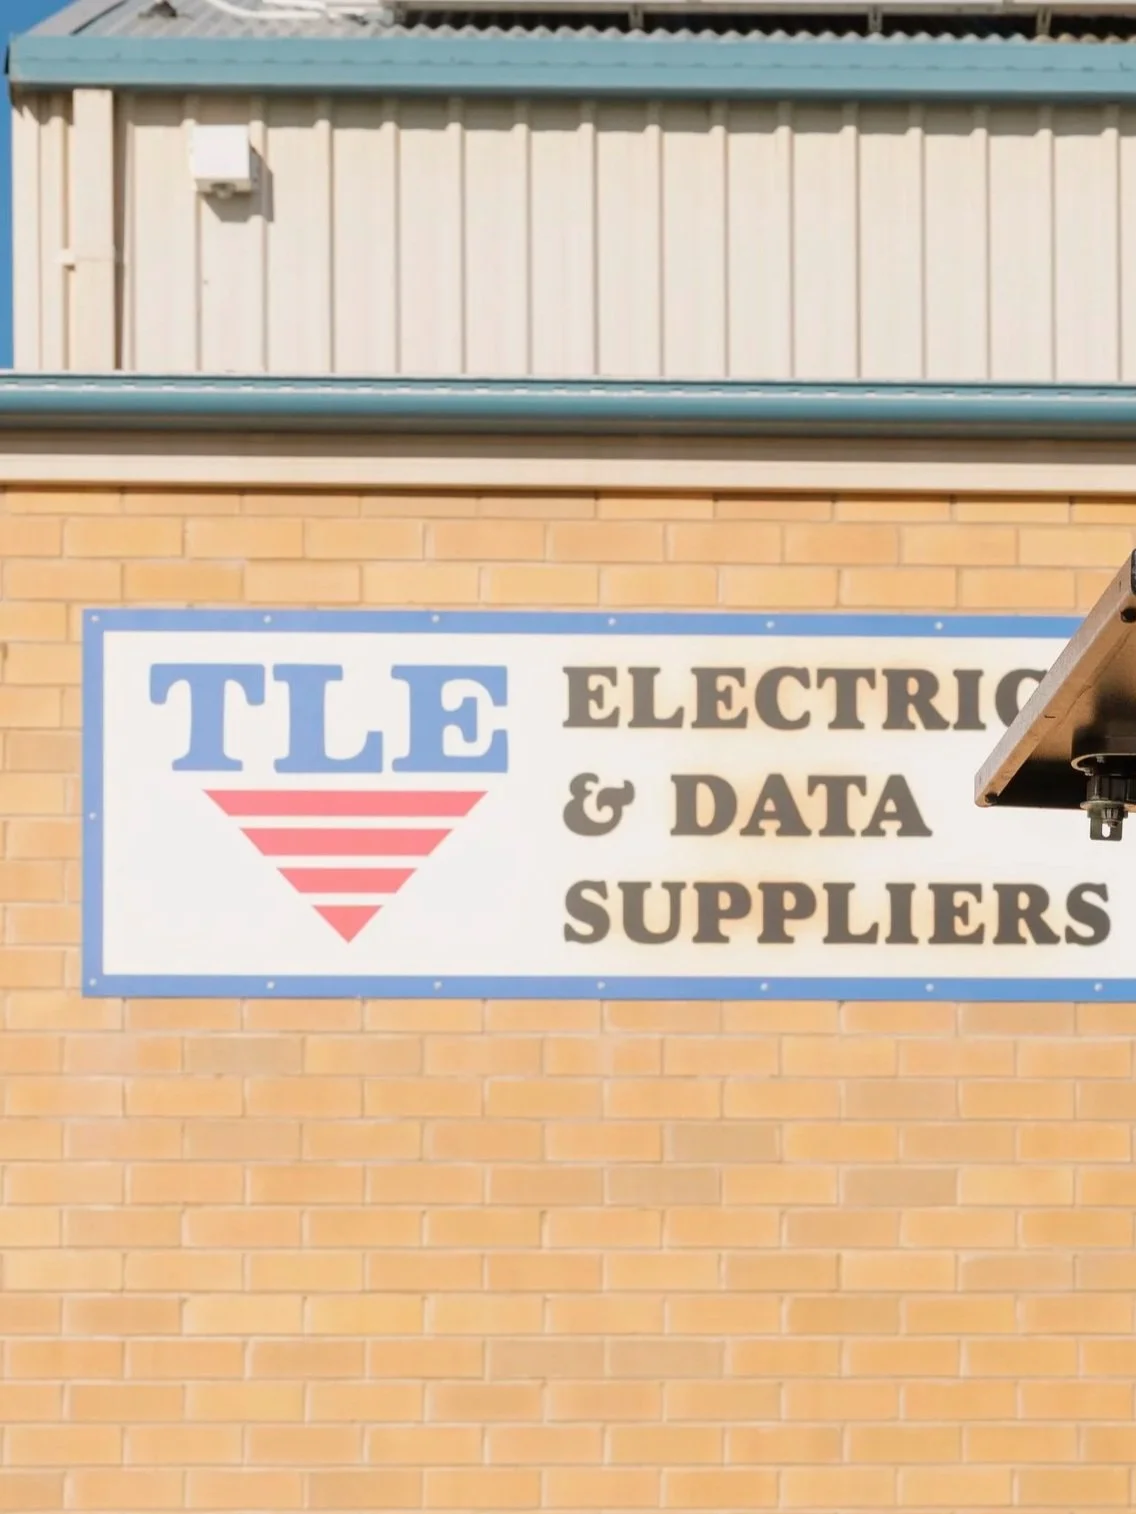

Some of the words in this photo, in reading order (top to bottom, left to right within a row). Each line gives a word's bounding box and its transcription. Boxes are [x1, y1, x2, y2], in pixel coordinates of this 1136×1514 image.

[150, 663, 508, 773] TLE
[563, 772, 636, 837] &
[670, 773, 933, 837] DATA
[564, 880, 1112, 946] SUPPLIERS
